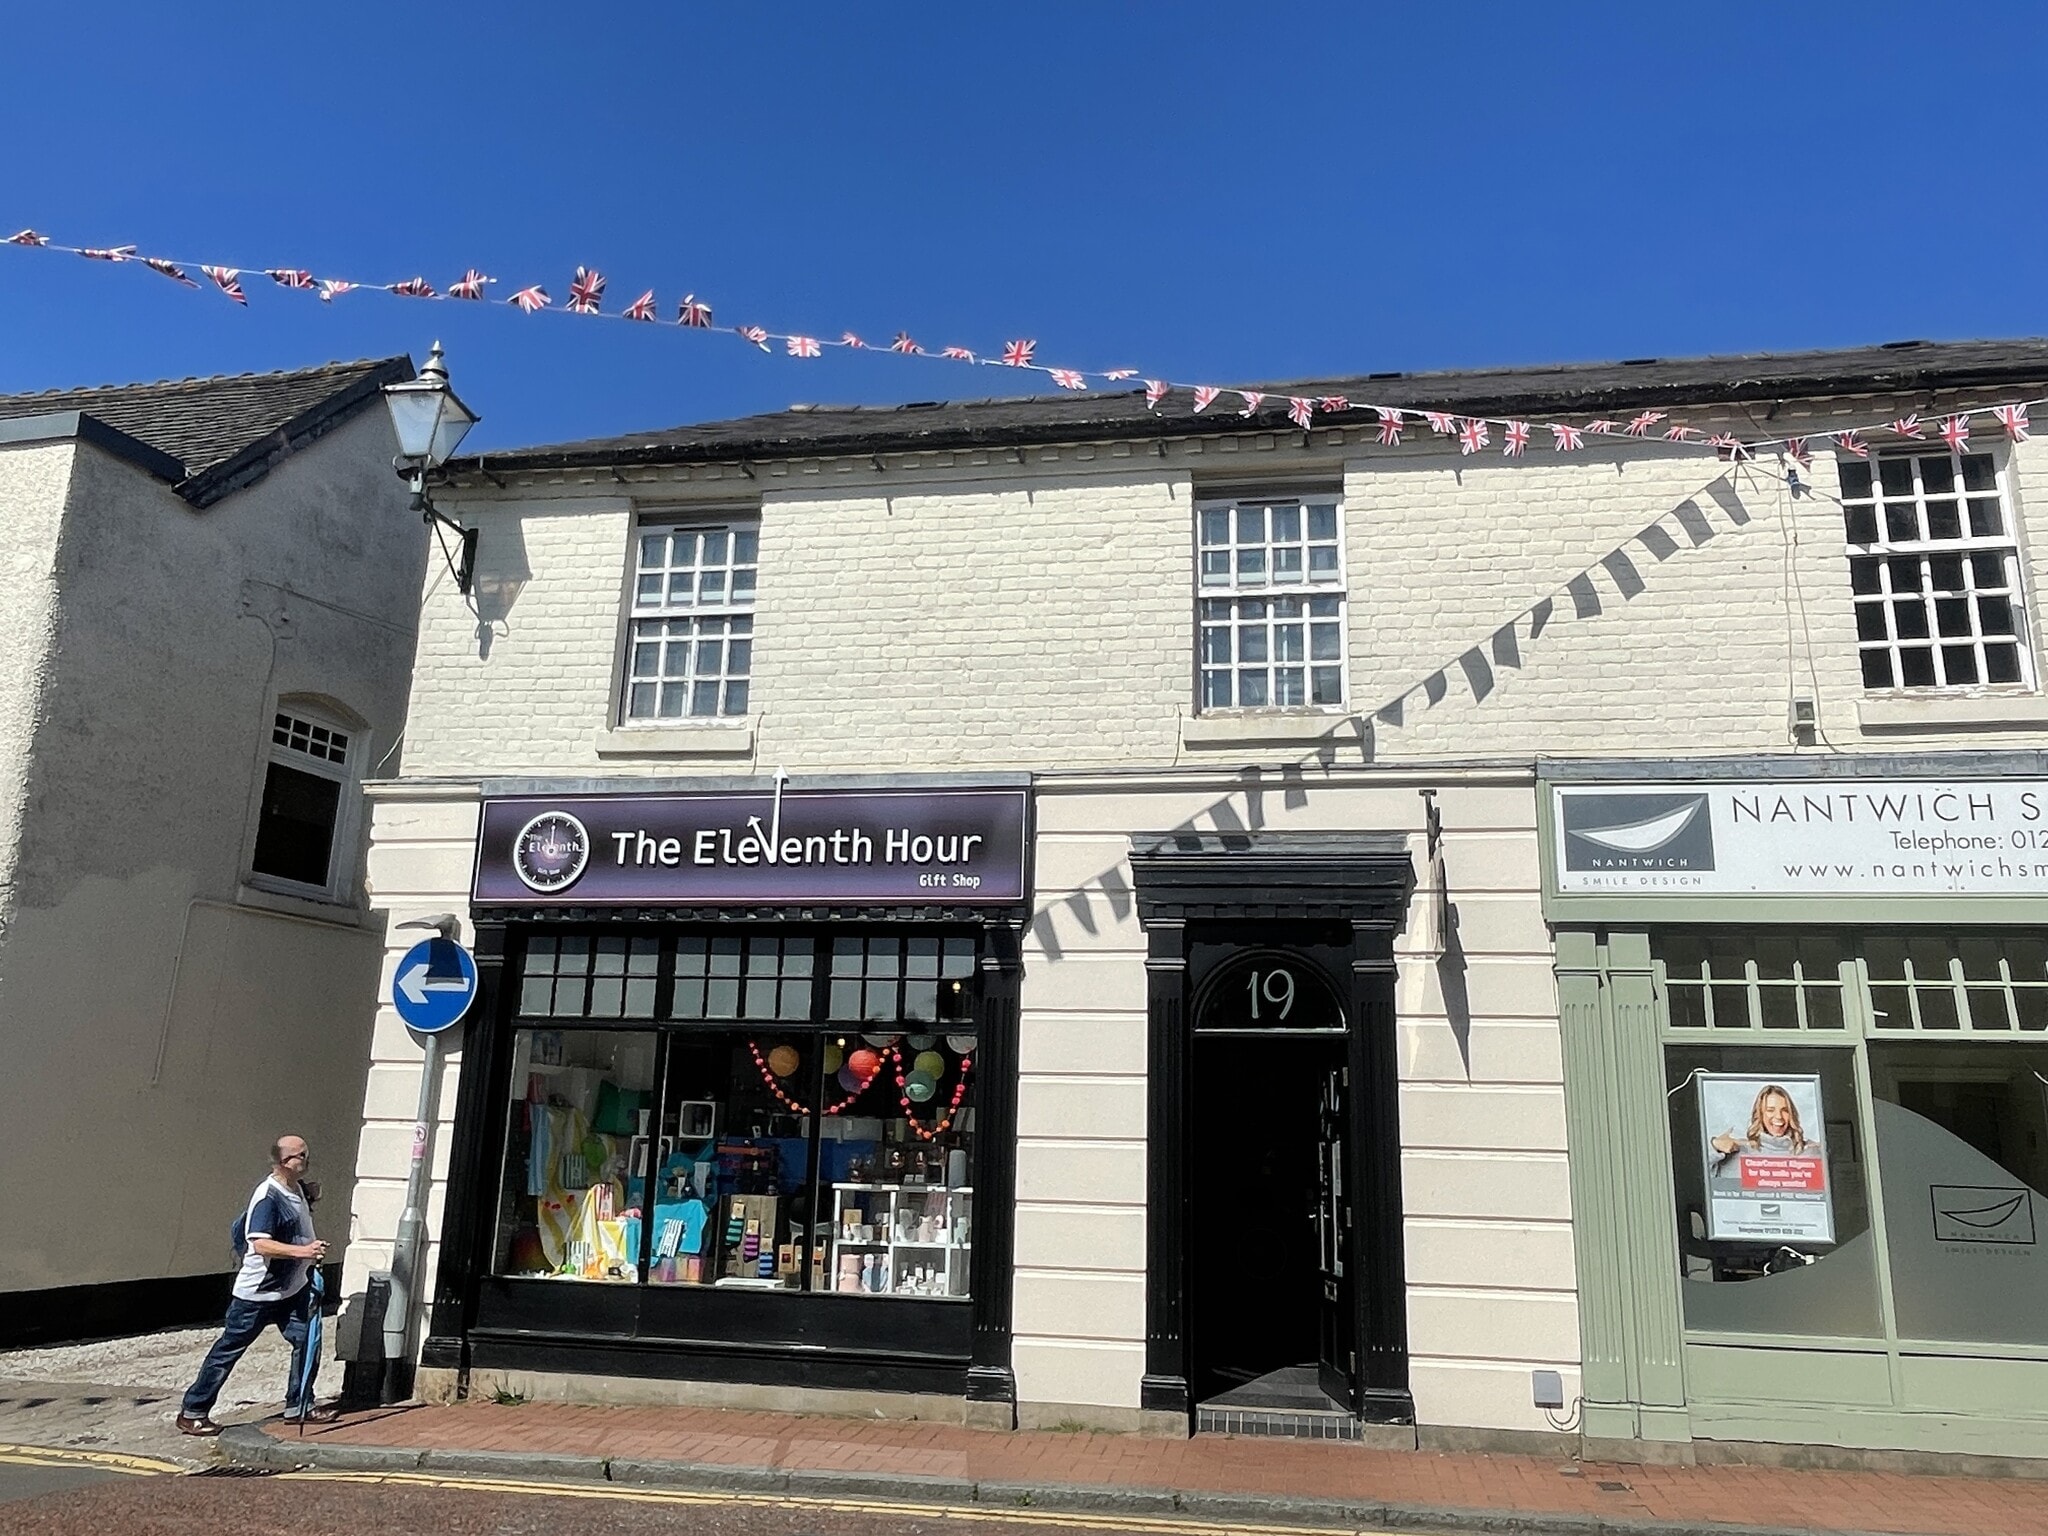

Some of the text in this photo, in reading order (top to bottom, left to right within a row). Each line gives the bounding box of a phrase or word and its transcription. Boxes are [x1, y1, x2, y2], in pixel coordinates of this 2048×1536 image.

[1731, 792, 2041, 823] NANTWICH S
[611, 815, 983, 865] The Eleventh Hour
[1888, 829, 2004, 856] Telephone:
[1592, 858, 1689, 868] NANTWICH
[919, 873, 981, 890] Gift Shop
[1582, 876, 1702, 887] SMILE DESIGN
[1246, 968, 1295, 1020] 19
